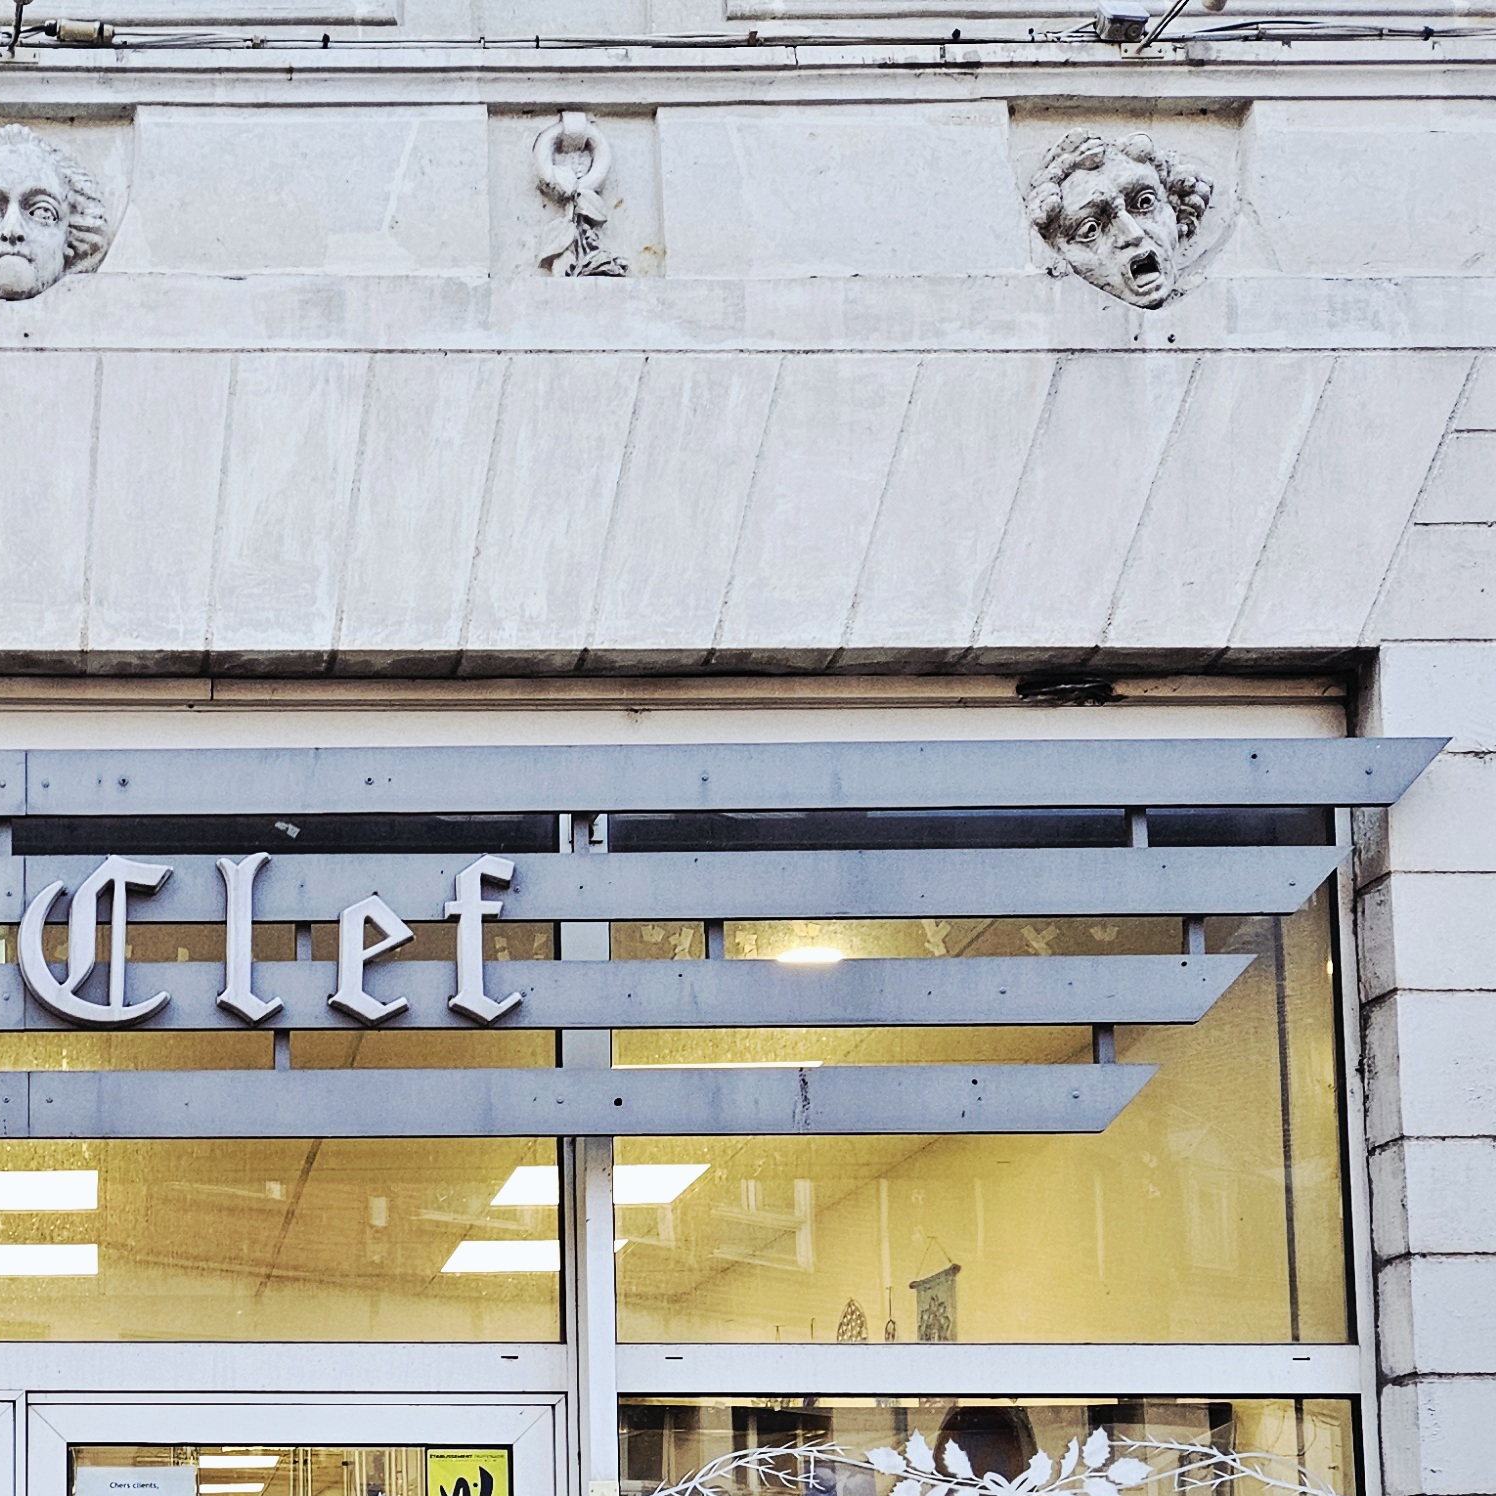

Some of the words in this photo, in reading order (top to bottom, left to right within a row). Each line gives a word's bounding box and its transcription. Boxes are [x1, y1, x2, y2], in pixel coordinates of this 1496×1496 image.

[18, 851, 525, 1029] Clef
[109, 1481, 130, 1489] Chers
[132, 1481, 159, 1490] clients,
